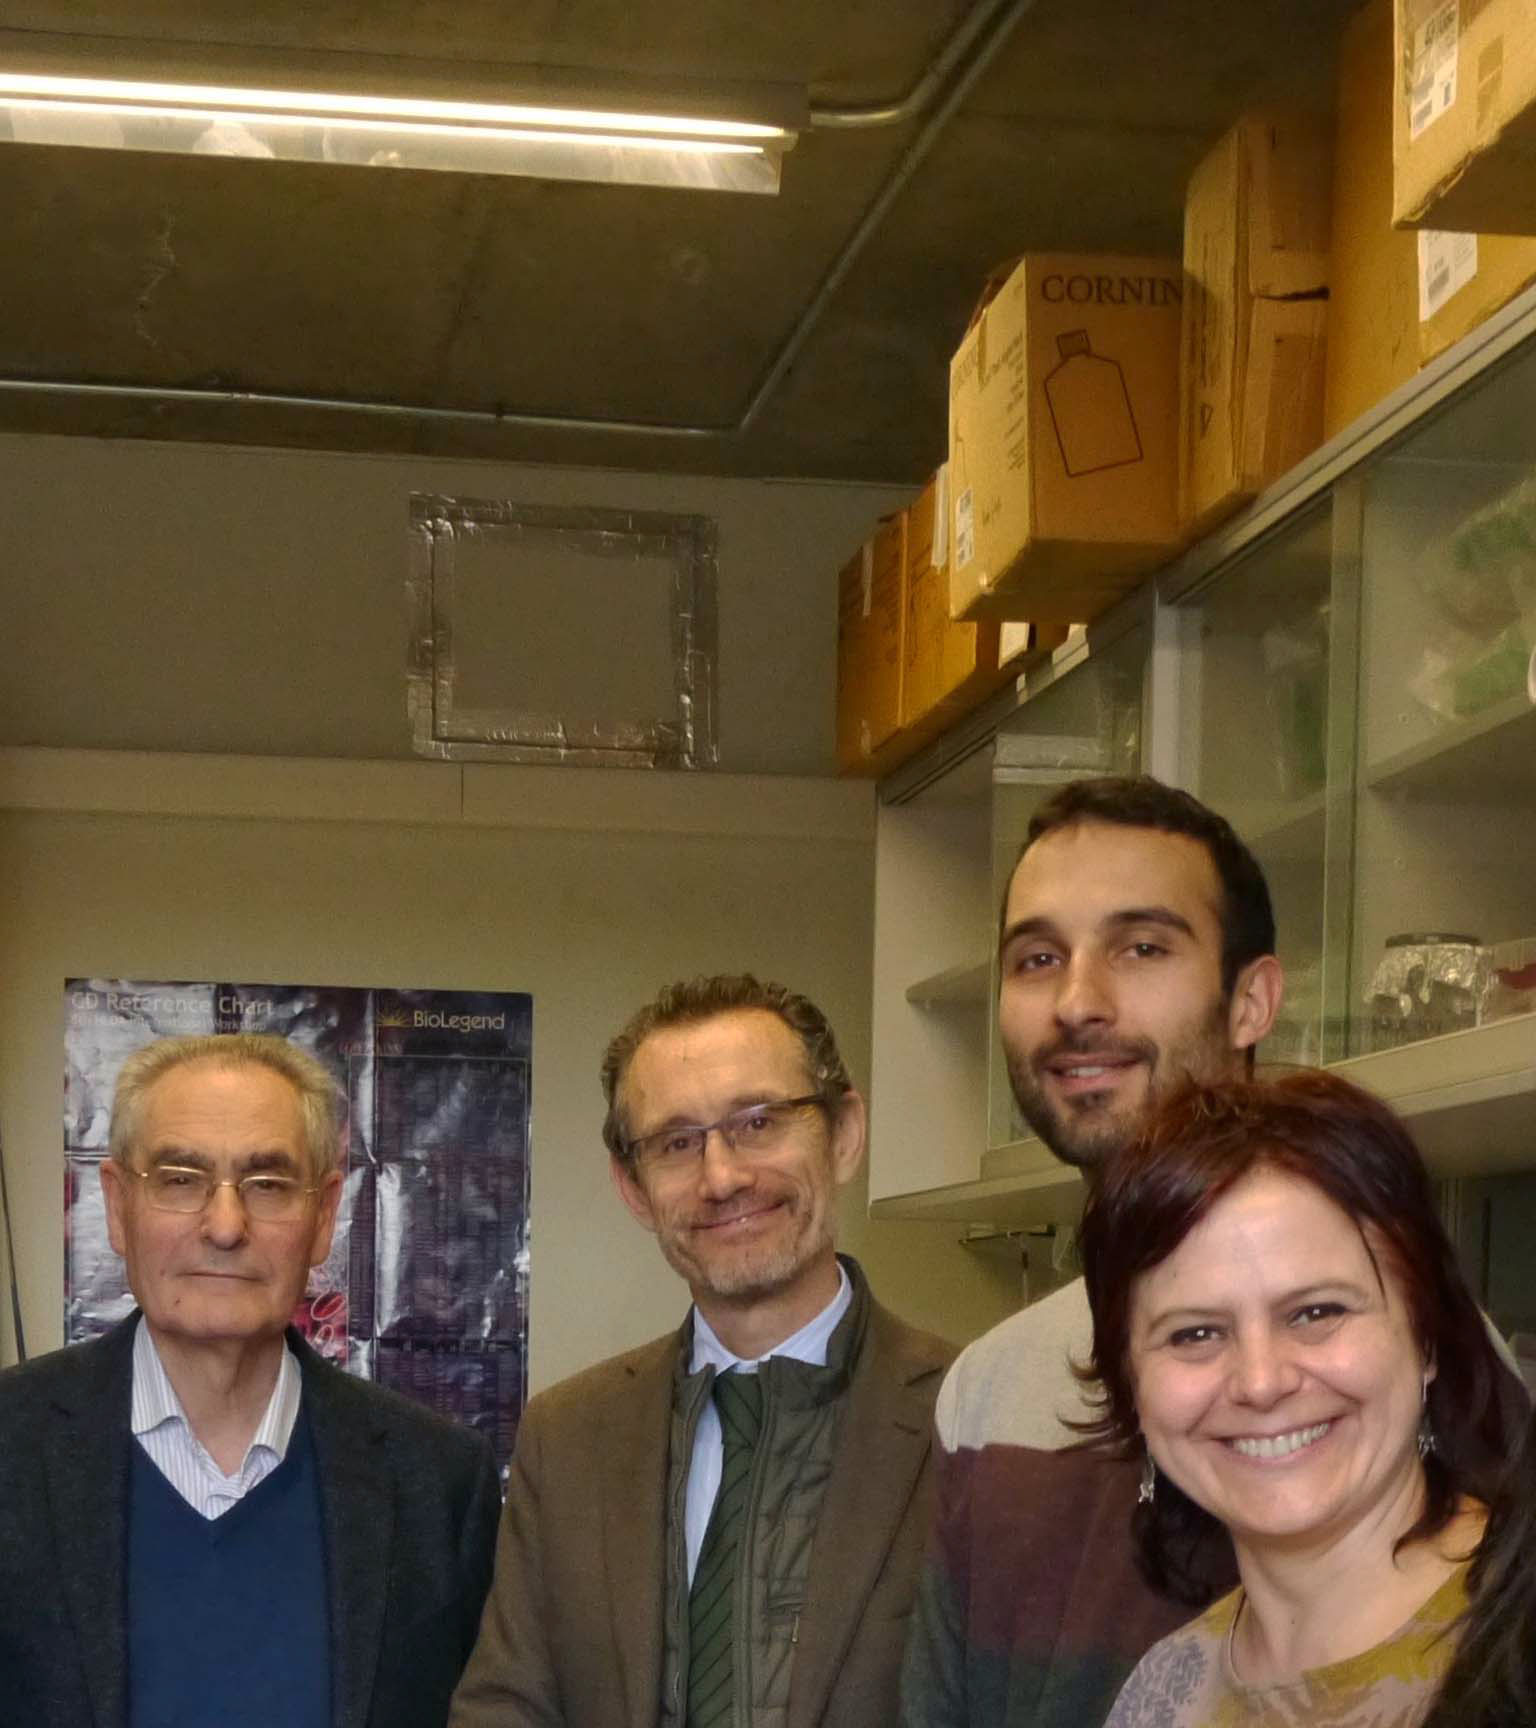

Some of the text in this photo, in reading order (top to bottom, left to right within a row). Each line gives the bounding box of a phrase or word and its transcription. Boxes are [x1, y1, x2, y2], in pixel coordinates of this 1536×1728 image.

[1041, 275, 1183, 306] CORNIN
[106, 993, 211, 1012] Reference
[218, 996, 275, 1016] Chart
[414, 1010, 505, 1032] BioLegend
